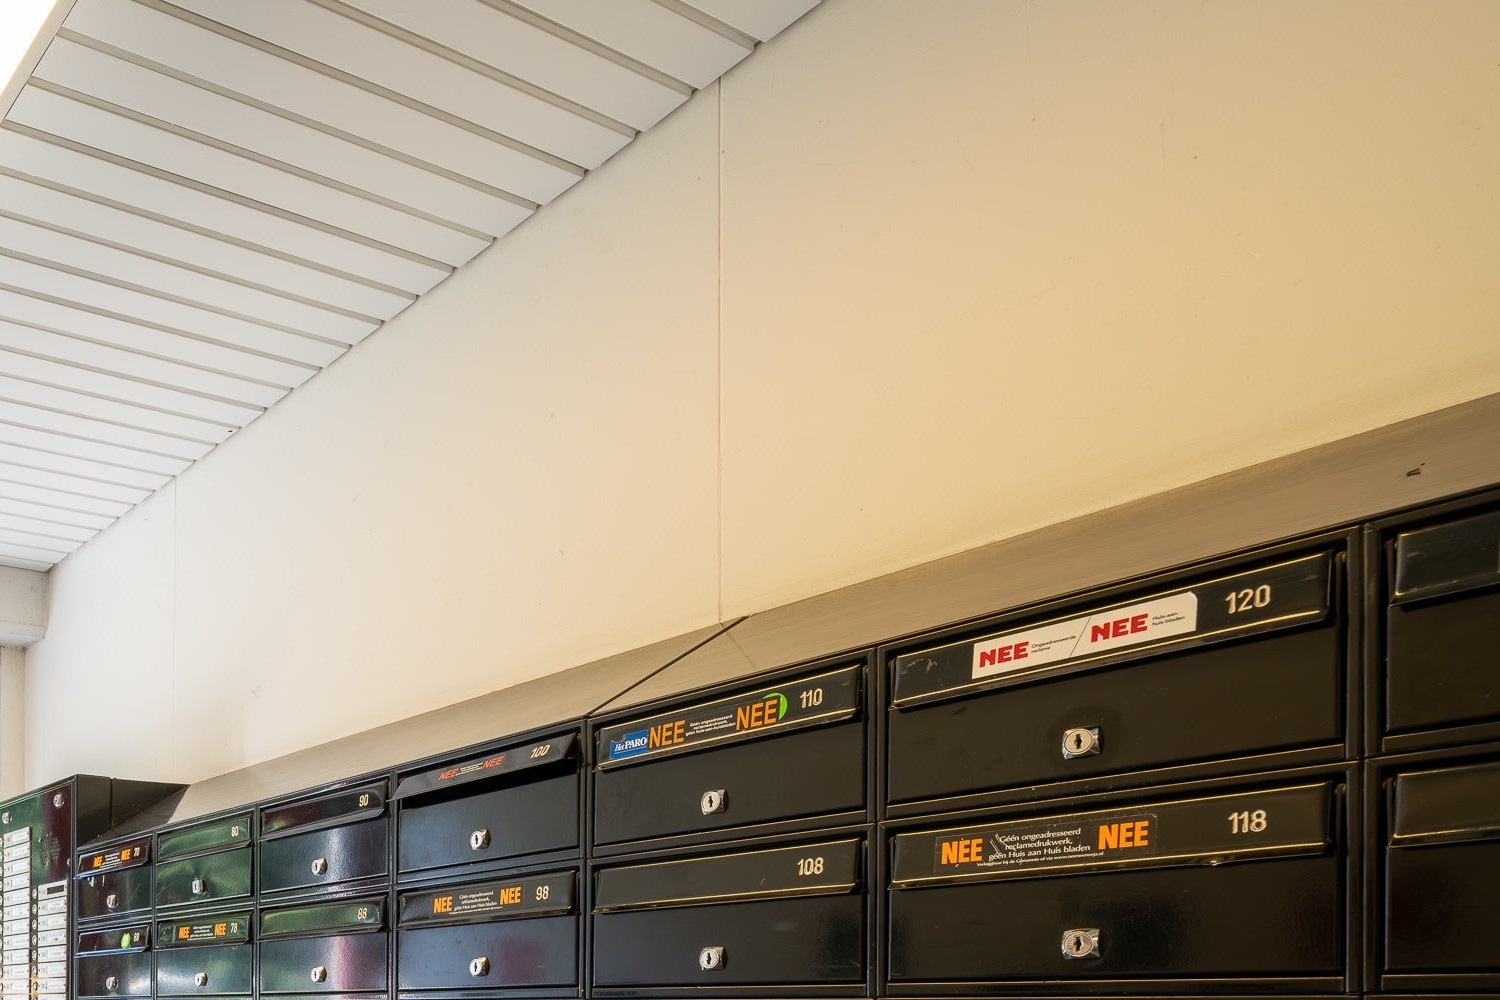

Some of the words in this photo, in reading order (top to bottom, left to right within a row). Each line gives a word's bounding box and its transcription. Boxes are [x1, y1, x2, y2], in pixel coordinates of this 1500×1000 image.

[1225, 584, 1271, 614] 120
[1091, 613, 1149, 643] NEE
[979, 641, 1029, 668] NEE
[800, 688, 823, 708] 110
[736, 698, 778, 731] NEE
[649, 720, 686, 748] NEE
[530, 744, 550, 758] 100
[624, 736, 648, 750] PARO
[482, 756, 504, 769] NEE
[439, 768, 460, 781] NEE
[359, 794, 368, 807] 90
[1228, 809, 1267, 834] 118
[1021, 828, 1082, 841] ongeadresseerd
[1098, 820, 1149, 850] NEE
[941, 838, 983, 865] NEE
[1008, 850, 1026, 858] Huis
[1044, 847, 1062, 855] Huis
[1064, 844, 1091, 853] bladen
[797, 856, 824, 876] 108
[500, 886, 522, 906] NEE
[536, 885, 550, 900] 98
[433, 896, 452, 914] NEE
[358, 908, 368, 920] 88
[178, 926, 190, 939] NEE
[214, 923, 226, 936] NEE
[230, 922, 238, 934] 78
